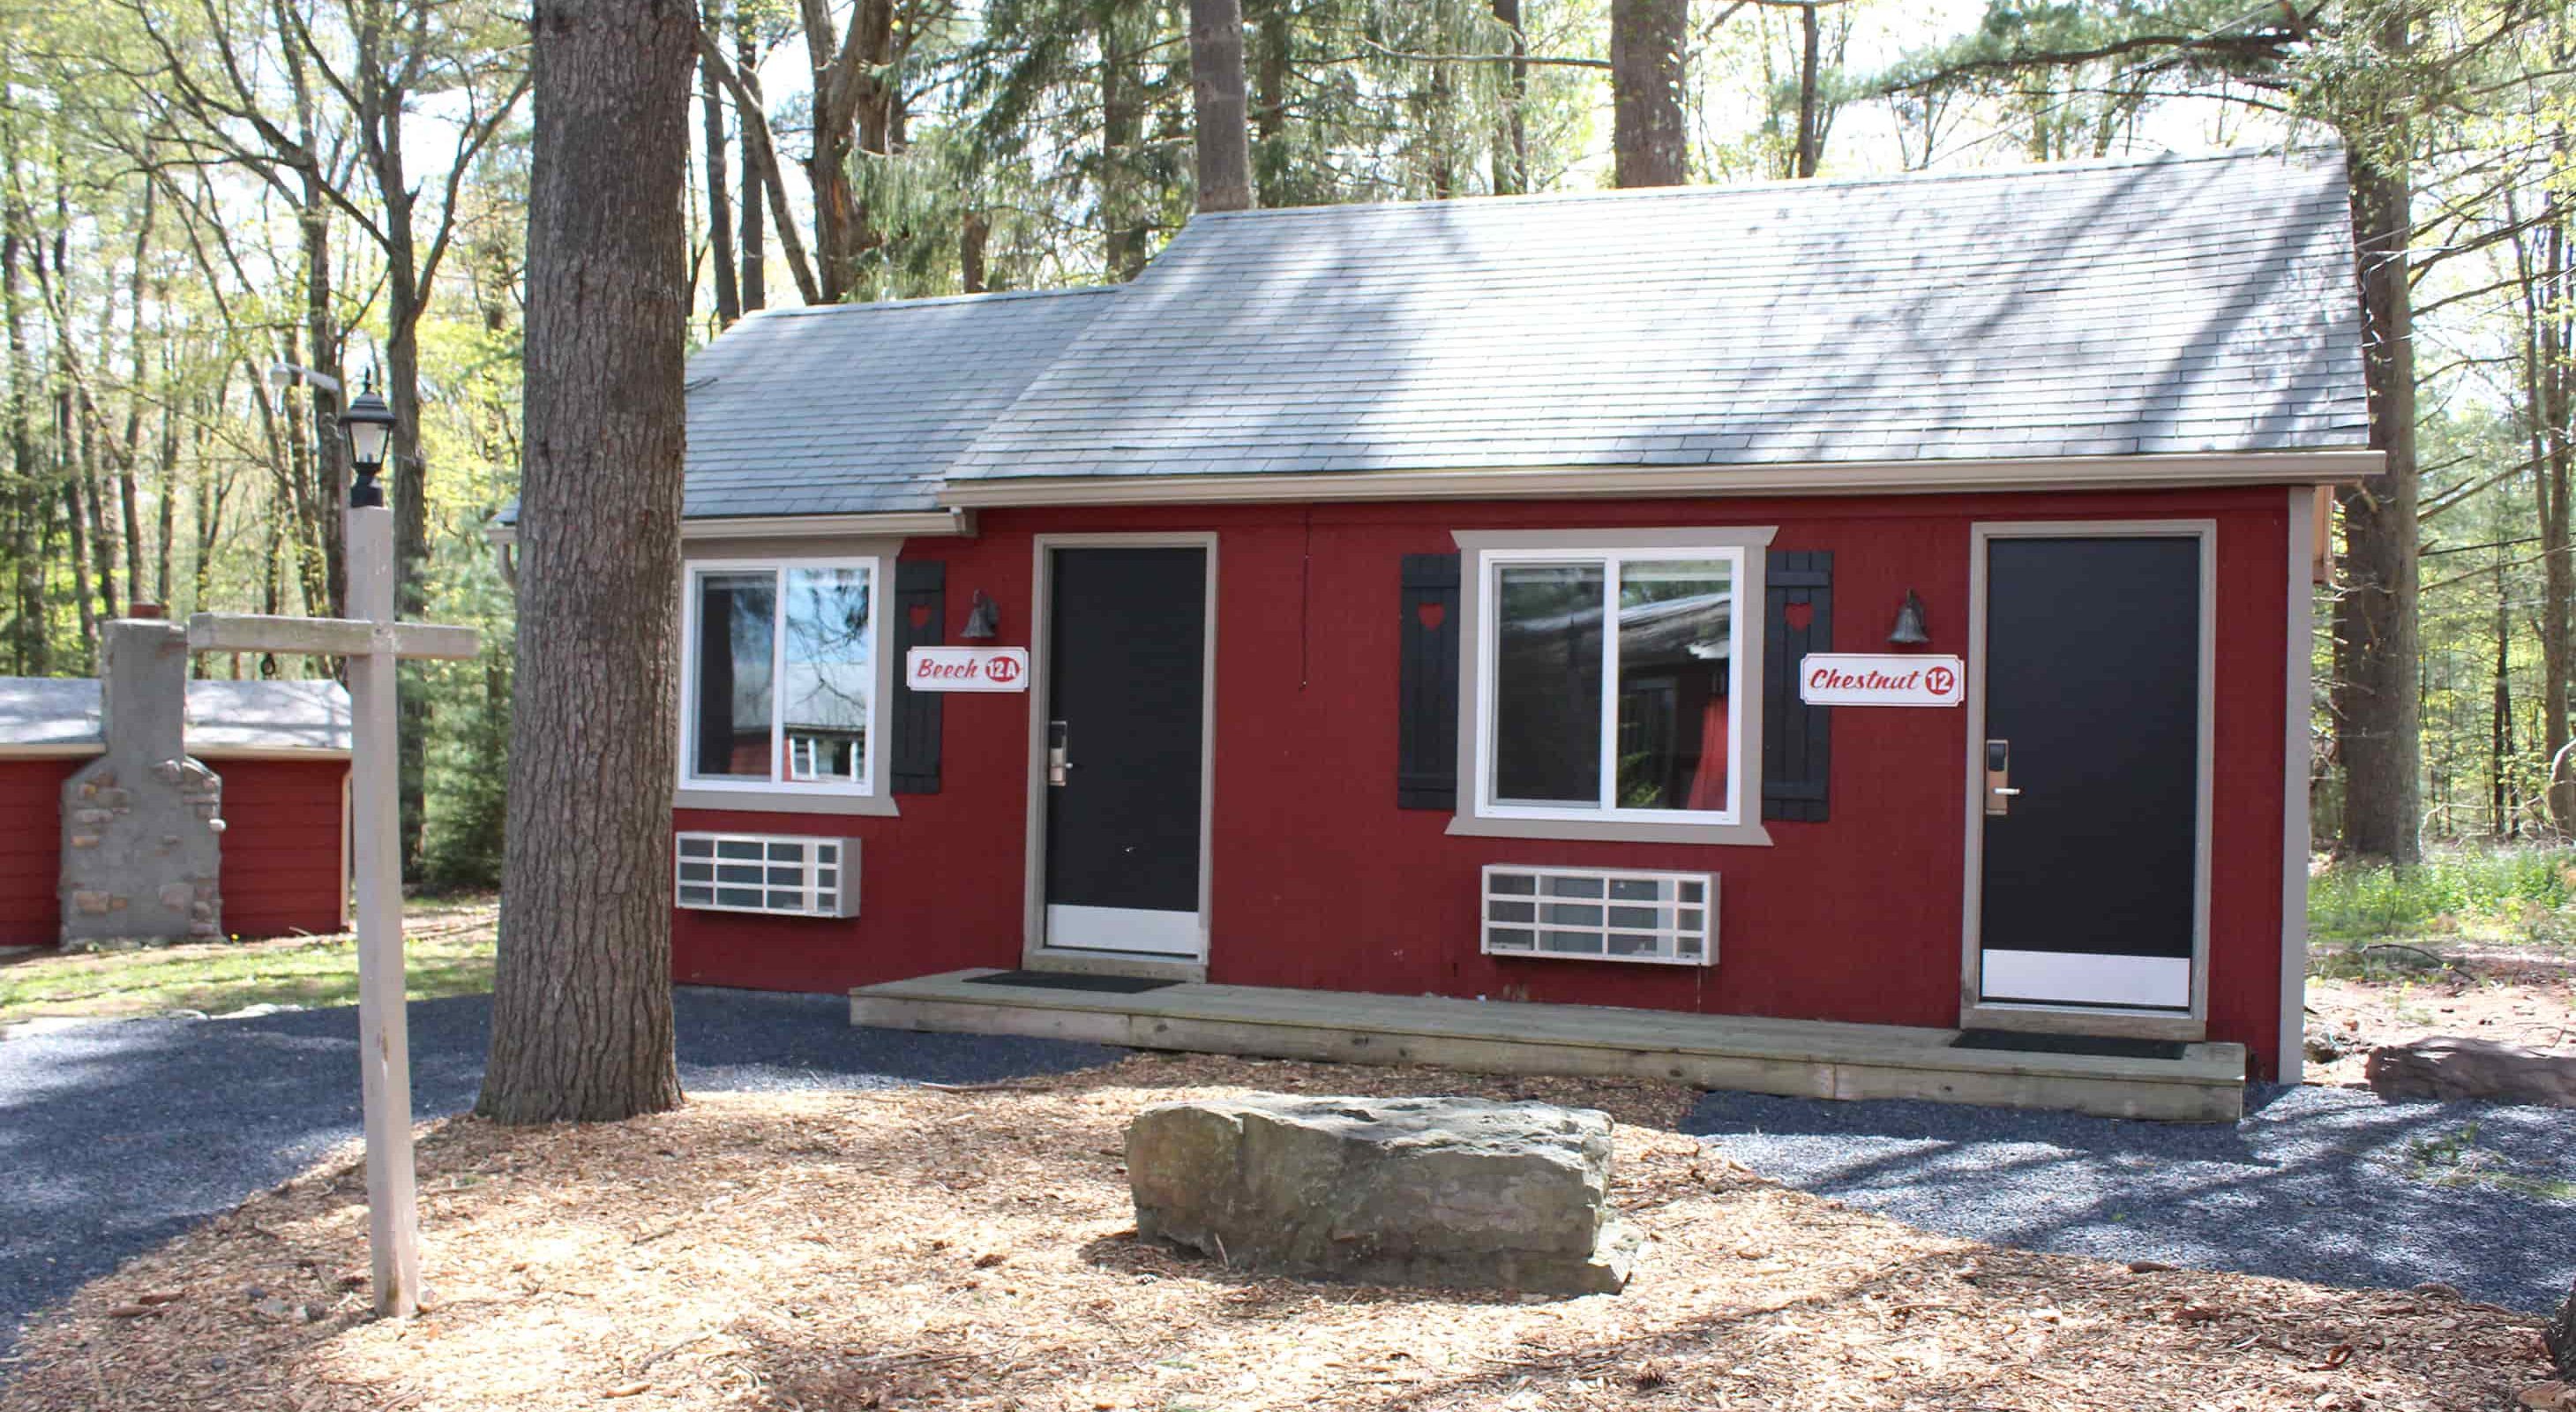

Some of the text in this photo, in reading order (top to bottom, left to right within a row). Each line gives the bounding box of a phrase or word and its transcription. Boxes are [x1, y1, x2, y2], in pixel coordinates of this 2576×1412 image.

[917, 658, 1018, 679] Beech 12A
[1810, 668, 1952, 691] Chestnut 12
